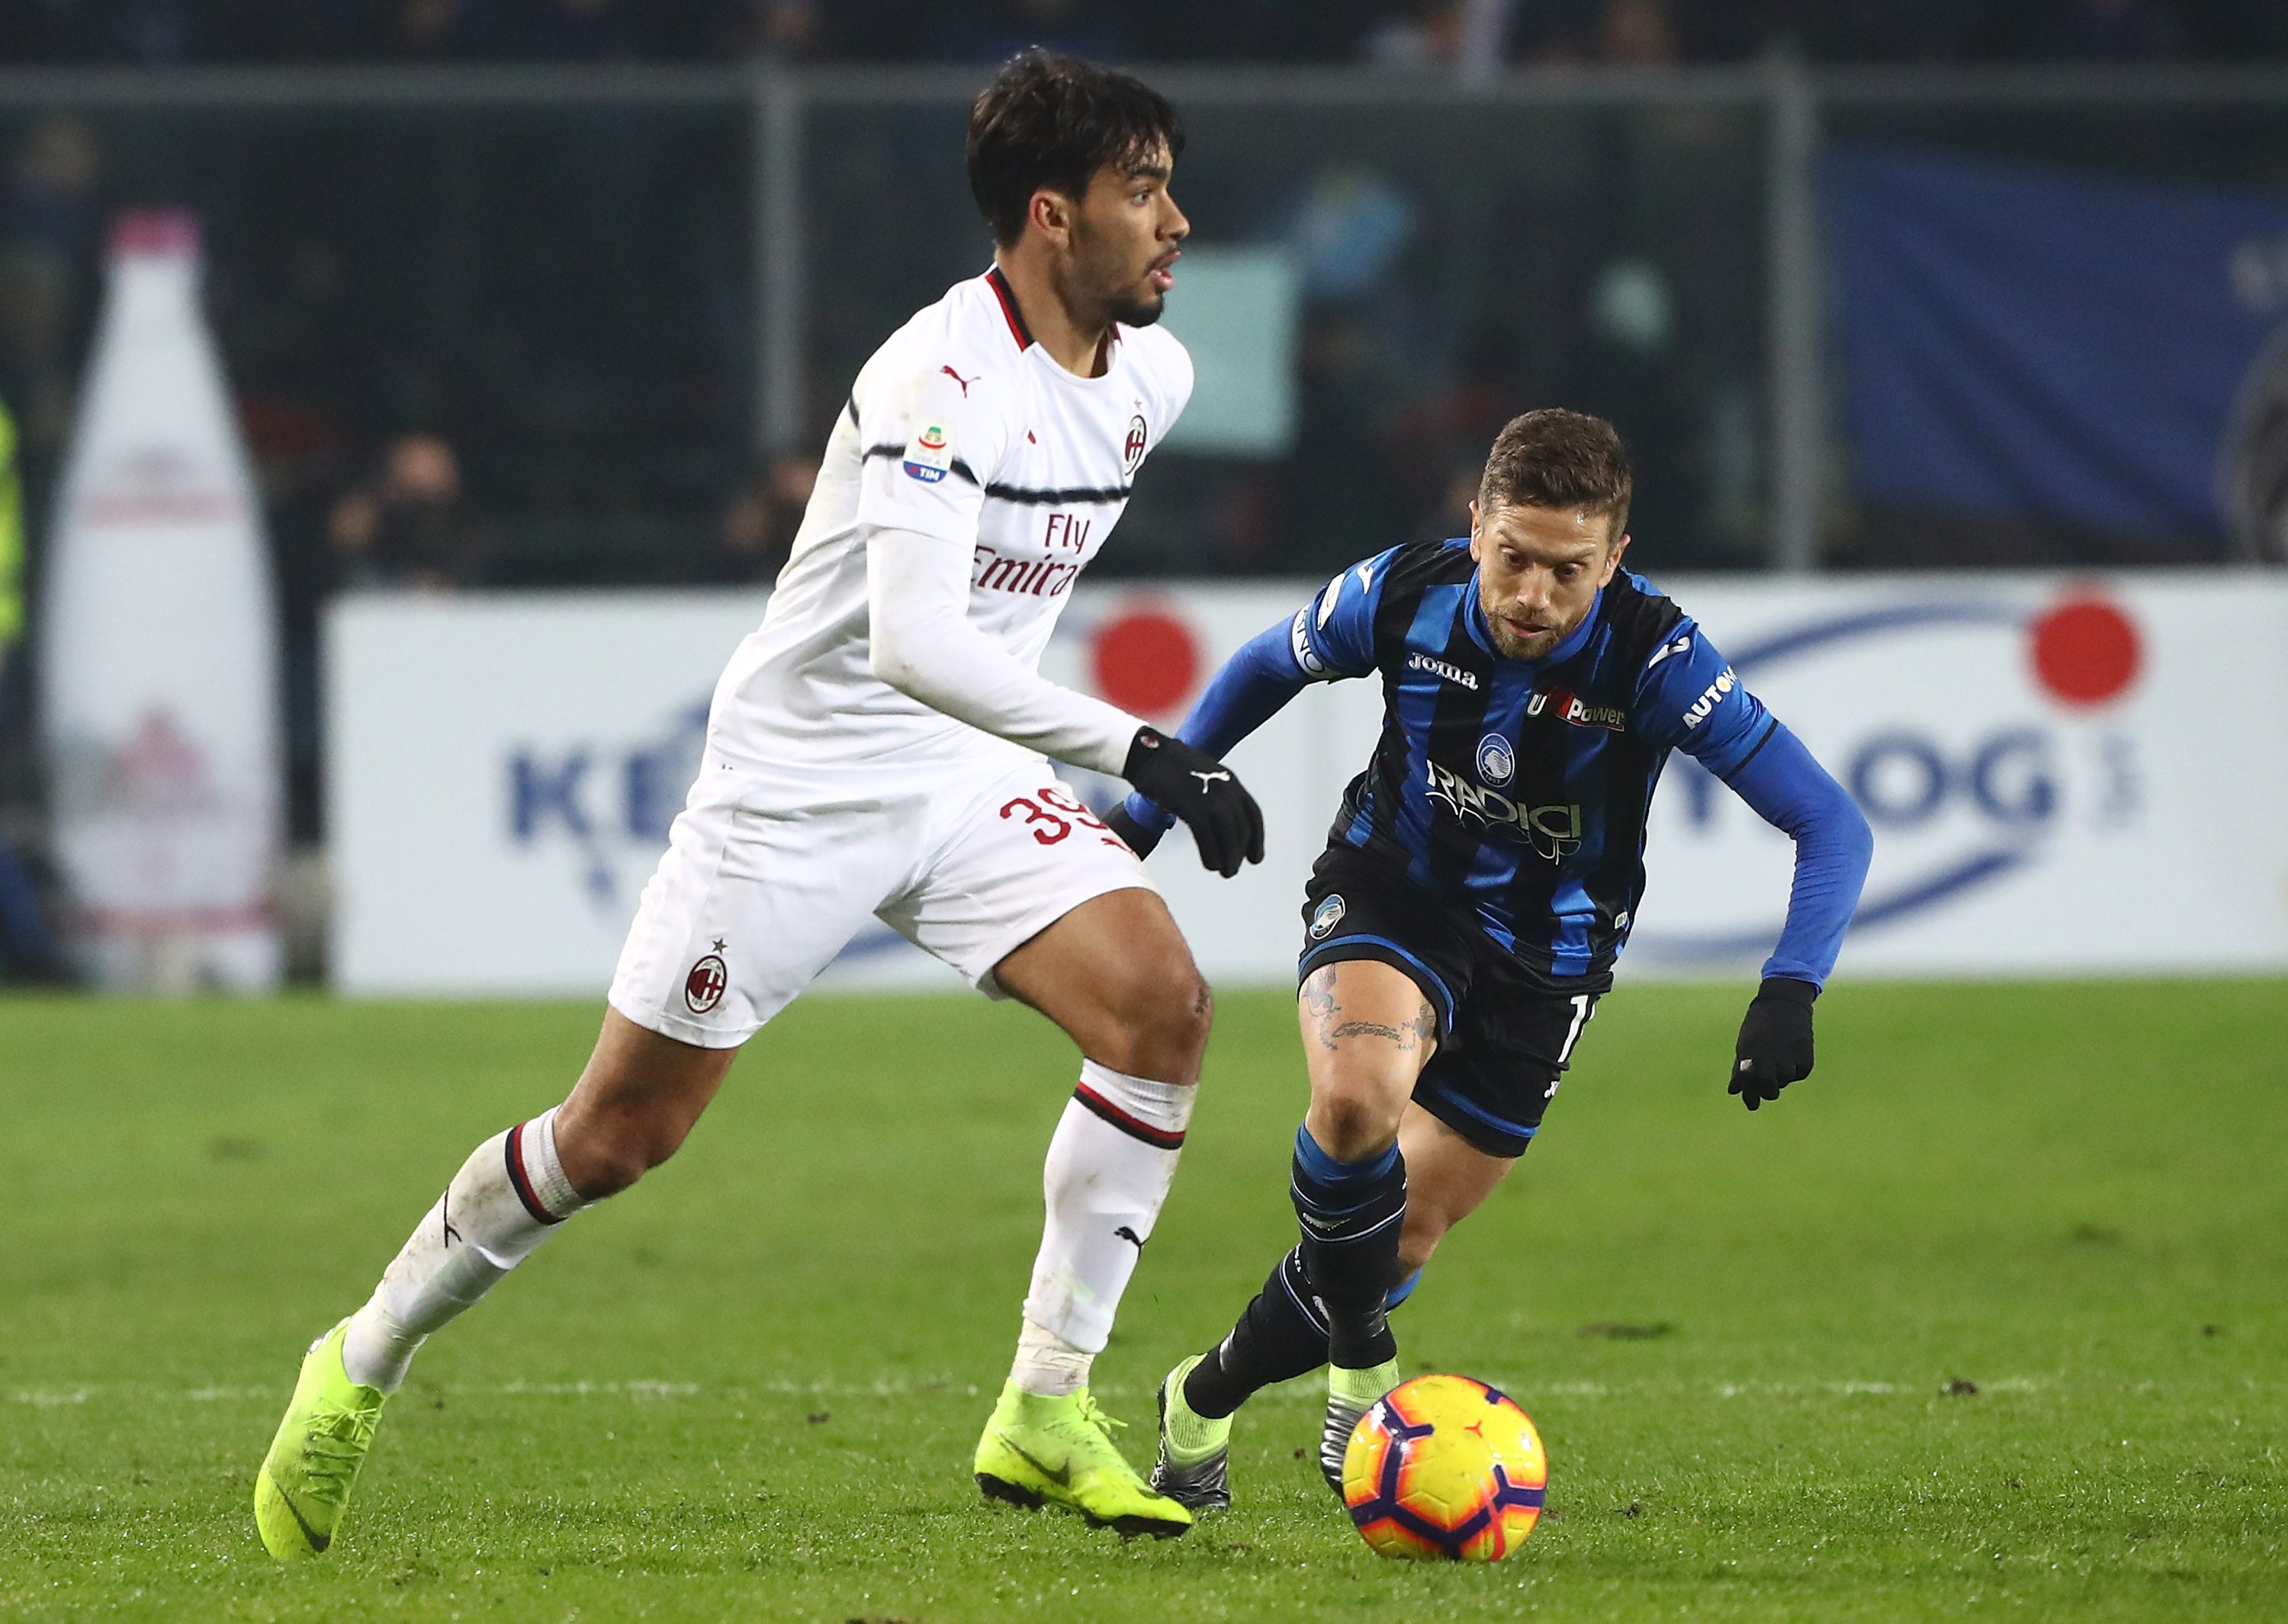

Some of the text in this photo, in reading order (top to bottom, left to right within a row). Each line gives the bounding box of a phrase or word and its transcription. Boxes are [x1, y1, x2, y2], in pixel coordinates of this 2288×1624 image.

[920, 467, 940, 481] TIM
[1045, 513, 1091, 555] Fly
[1408, 652, 1480, 691] Joma
[999, 788, 1109, 846] 39
[1426, 759, 1582, 839] RADICI
[1557, 995, 1596, 1063] 1
